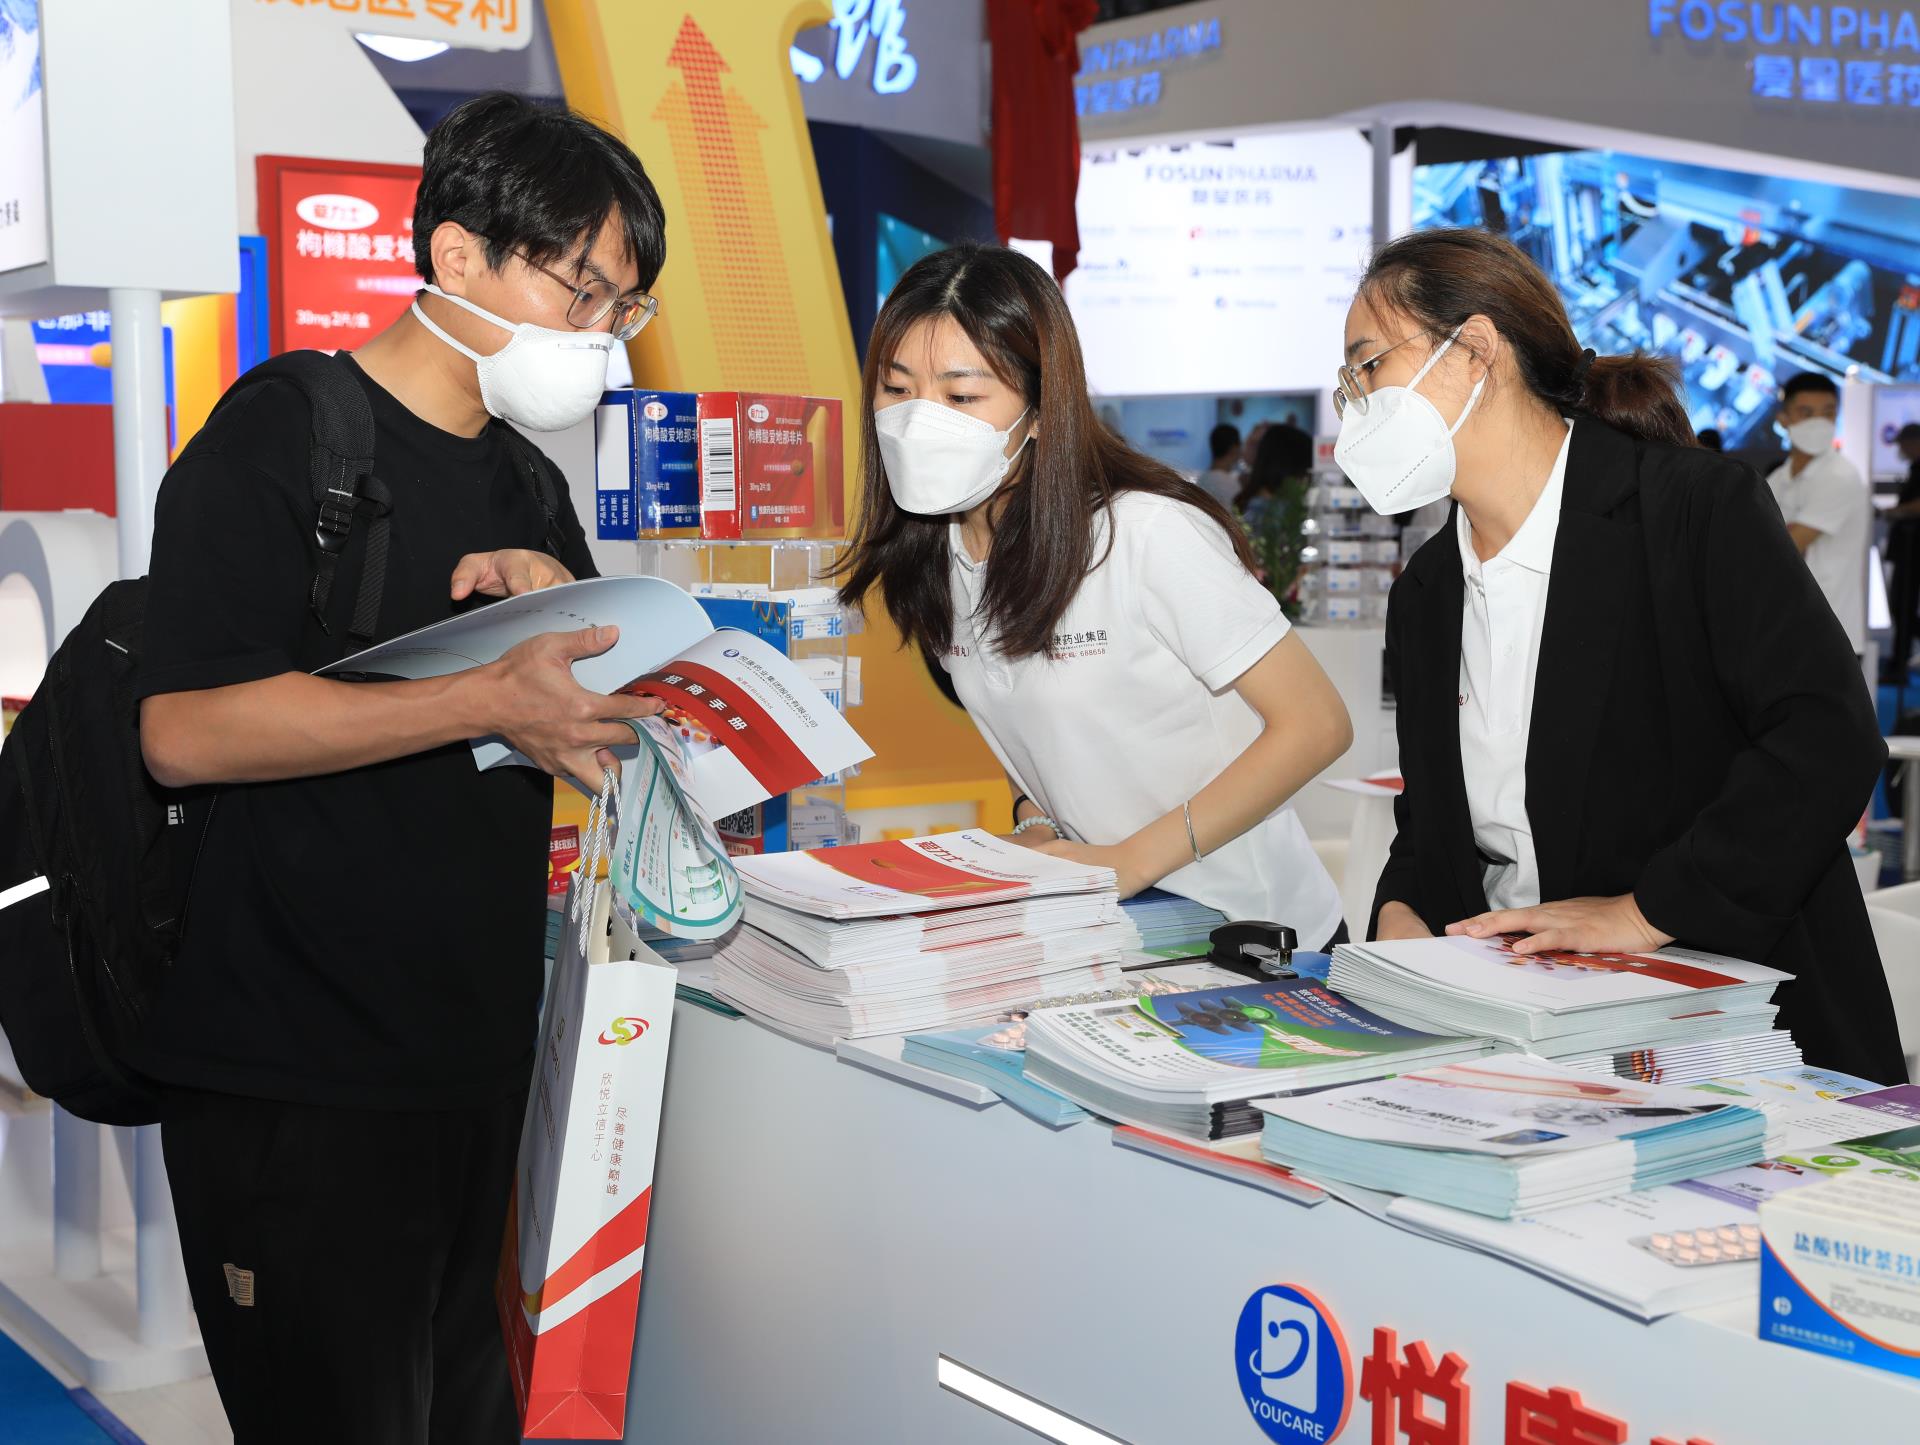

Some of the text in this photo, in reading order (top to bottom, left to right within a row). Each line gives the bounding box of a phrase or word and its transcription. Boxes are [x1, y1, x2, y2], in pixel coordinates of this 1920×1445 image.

[1648, 0, 1822, 47] FOSUN
[1144, 164, 1318, 183] FOSUN PHARMA
[662, 674, 748, 732] 招商手册
[590, 1072, 612, 1162] 欣悦立信于心
[606, 1106, 628, 1196] 尽善健康巅峰
[1794, 1232, 1920, 1278] 盐酸特比萘芬
[1250, 1397, 1325, 1442] YOUCARE
